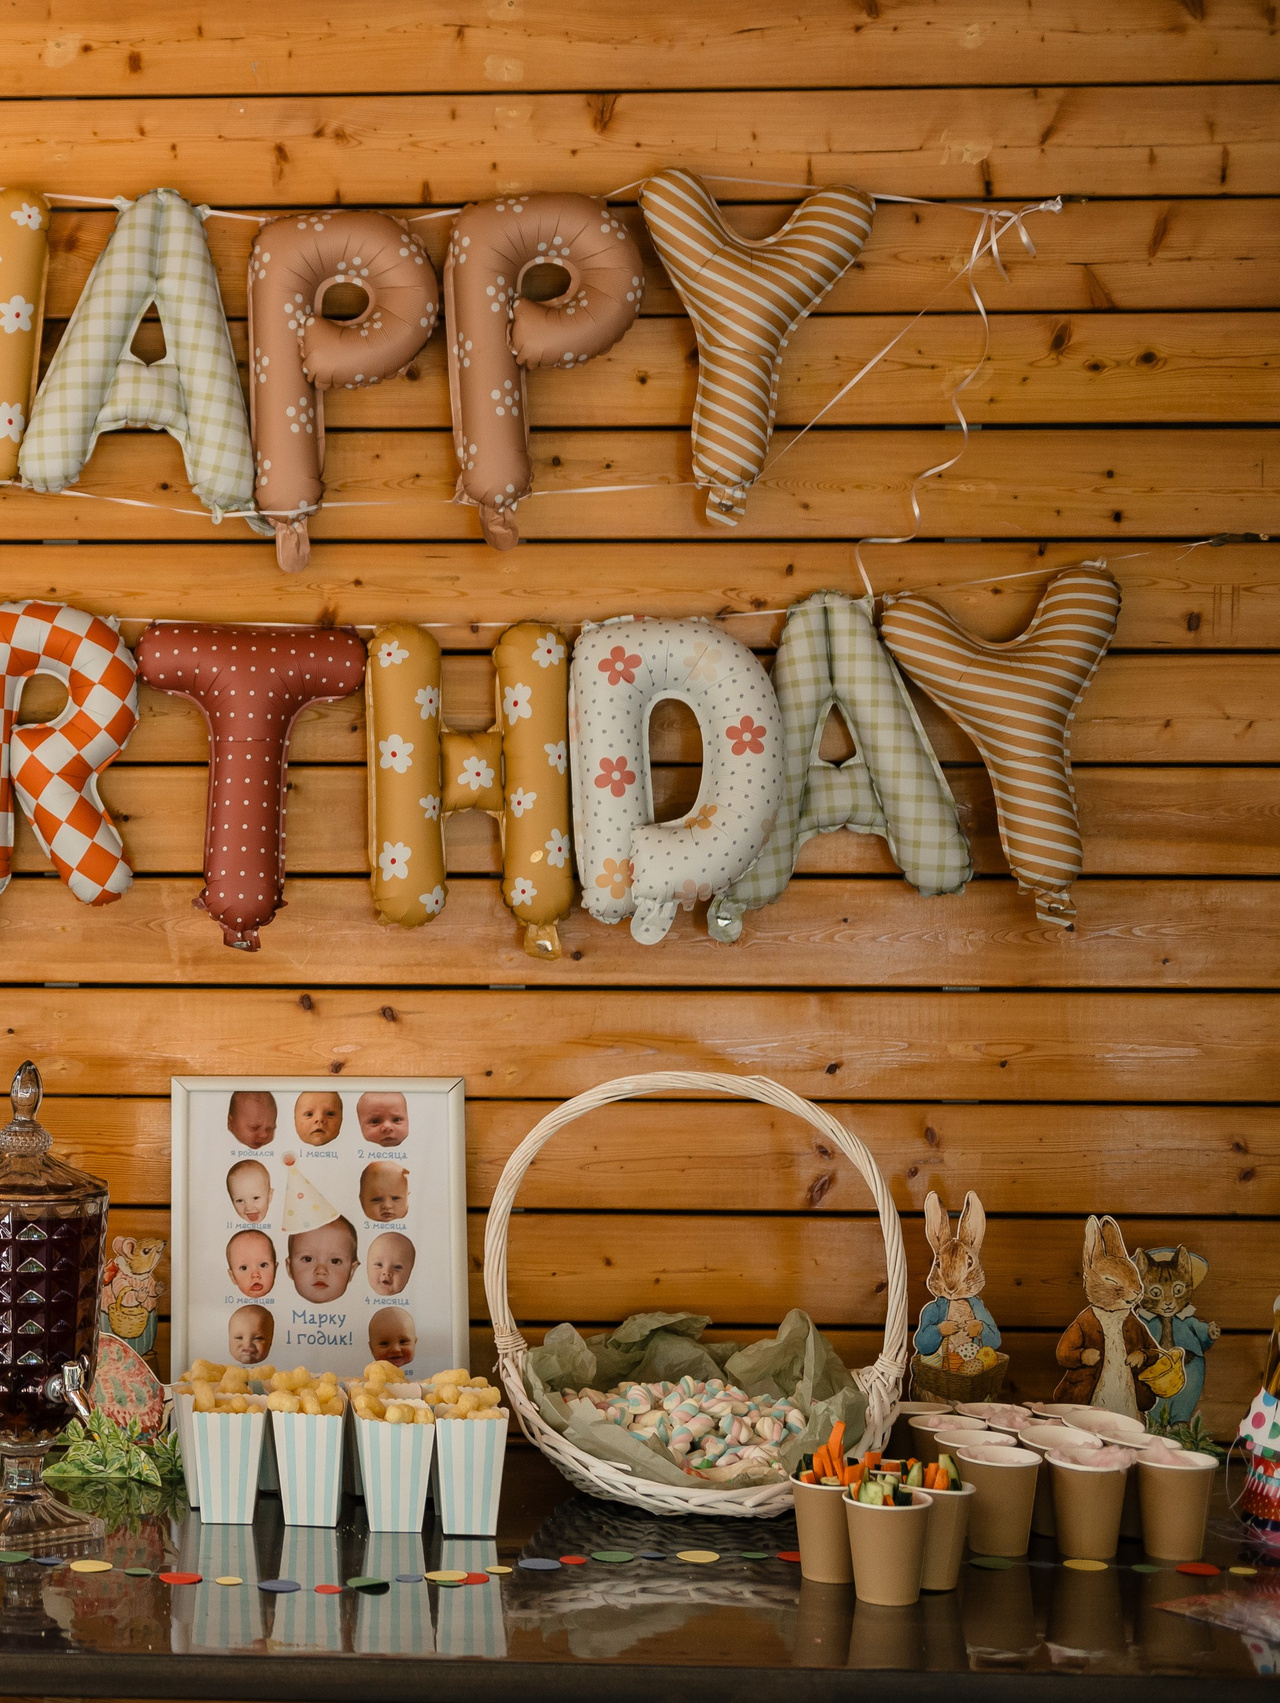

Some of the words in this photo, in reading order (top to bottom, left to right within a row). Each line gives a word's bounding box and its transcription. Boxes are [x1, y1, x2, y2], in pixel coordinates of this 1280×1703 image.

[238, 1150, 274, 1158] родился
[306, 1150, 338, 1159] месяц
[358, 1149, 364, 1158] 2
[367, 1151, 408, 1160] месяца
[364, 1221, 370, 1230] 3
[224, 1296, 234, 1304] 10
[236, 1297, 275, 1305] месяцев
[365, 1296, 371, 1304] 4
[373, 1297, 410, 1306] месяца
[292, 1310, 347, 1328] Марку
[286, 1330, 291, 1345] 1
[297, 1330, 353, 1346] годик!
